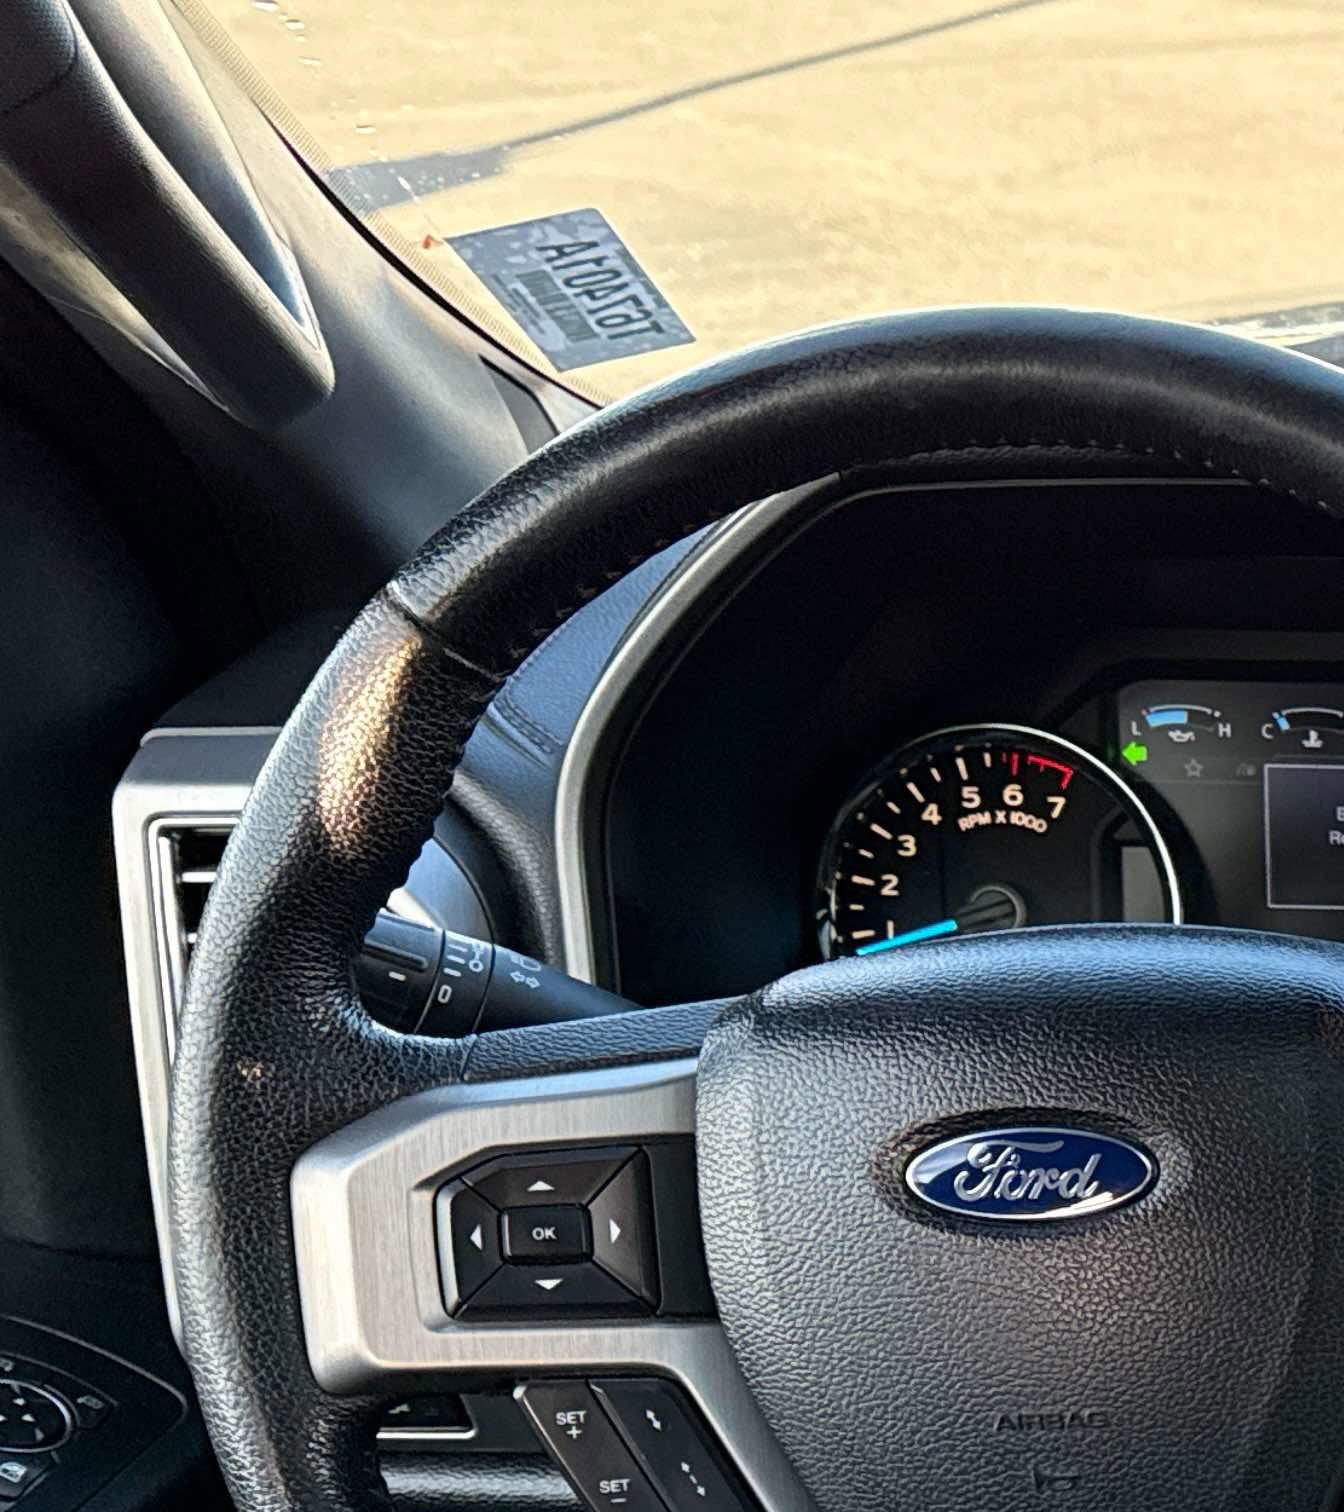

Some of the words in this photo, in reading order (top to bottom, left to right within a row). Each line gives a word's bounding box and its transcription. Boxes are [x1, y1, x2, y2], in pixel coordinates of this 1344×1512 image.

[1131, 721, 1141, 736] L
[1218, 723, 1232, 738] H
[1261, 724, 1274, 740] C
[961, 786, 981, 809] 5
[1002, 784, 1024, 806] 6
[920, 803, 942, 826] 4
[1046, 796, 1066, 819] 7
[957, 811, 992, 832] RPM
[995, 810, 1007, 825] X
[1009, 810, 1048, 834] 1000
[897, 834, 918, 857] 3
[880, 874, 900, 897] 2
[953, 1139, 1103, 1202] Ford
[532, 1226, 557, 1240] OK
[556, 1410, 586, 1424] SET
[599, 1478, 632, 1493] SET
